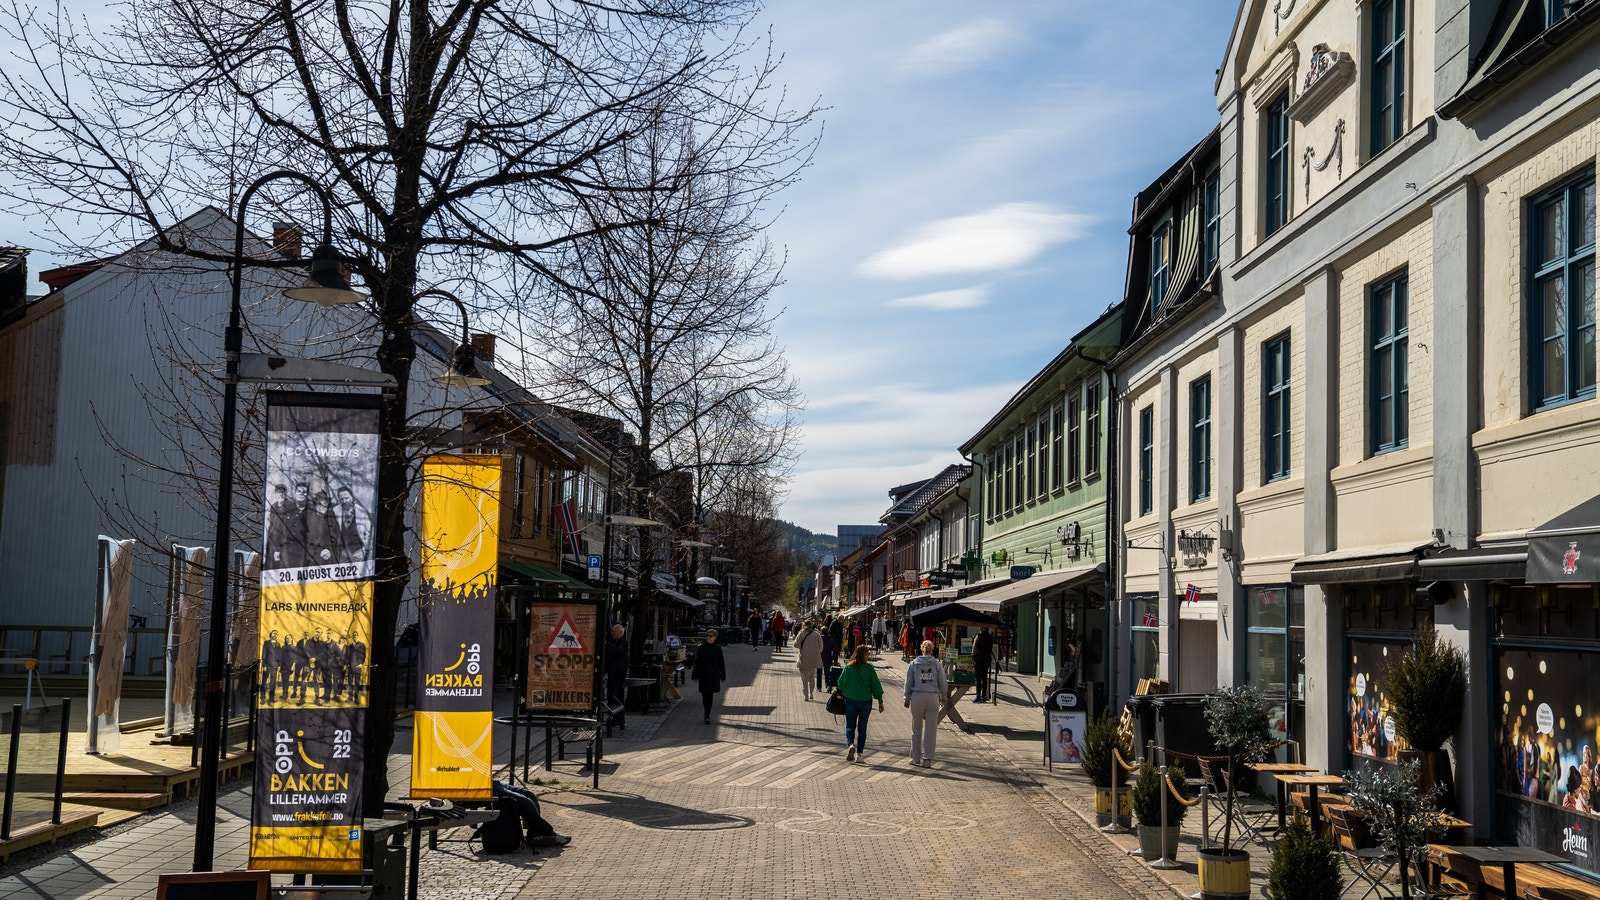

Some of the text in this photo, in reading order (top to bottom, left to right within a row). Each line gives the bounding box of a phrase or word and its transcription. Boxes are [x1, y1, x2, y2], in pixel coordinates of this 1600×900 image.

[286, 447, 359, 458] CC COWBOYS
[591, 557, 598, 567] P
[280, 565, 357, 582] 20. AUGUST 2022
[265, 602, 292, 611] LARS
[534, 653, 593, 669] STOPP
[545, 690, 590, 703] NIKKERS
[334, 730, 351, 743] 20
[275, 730, 293, 774] OPP
[333, 745, 351, 758] 22
[270, 773, 349, 792] BAKKEN
[269, 793, 347, 805] LILLEHAMMER
[1562, 827, 1587, 853] Heim
